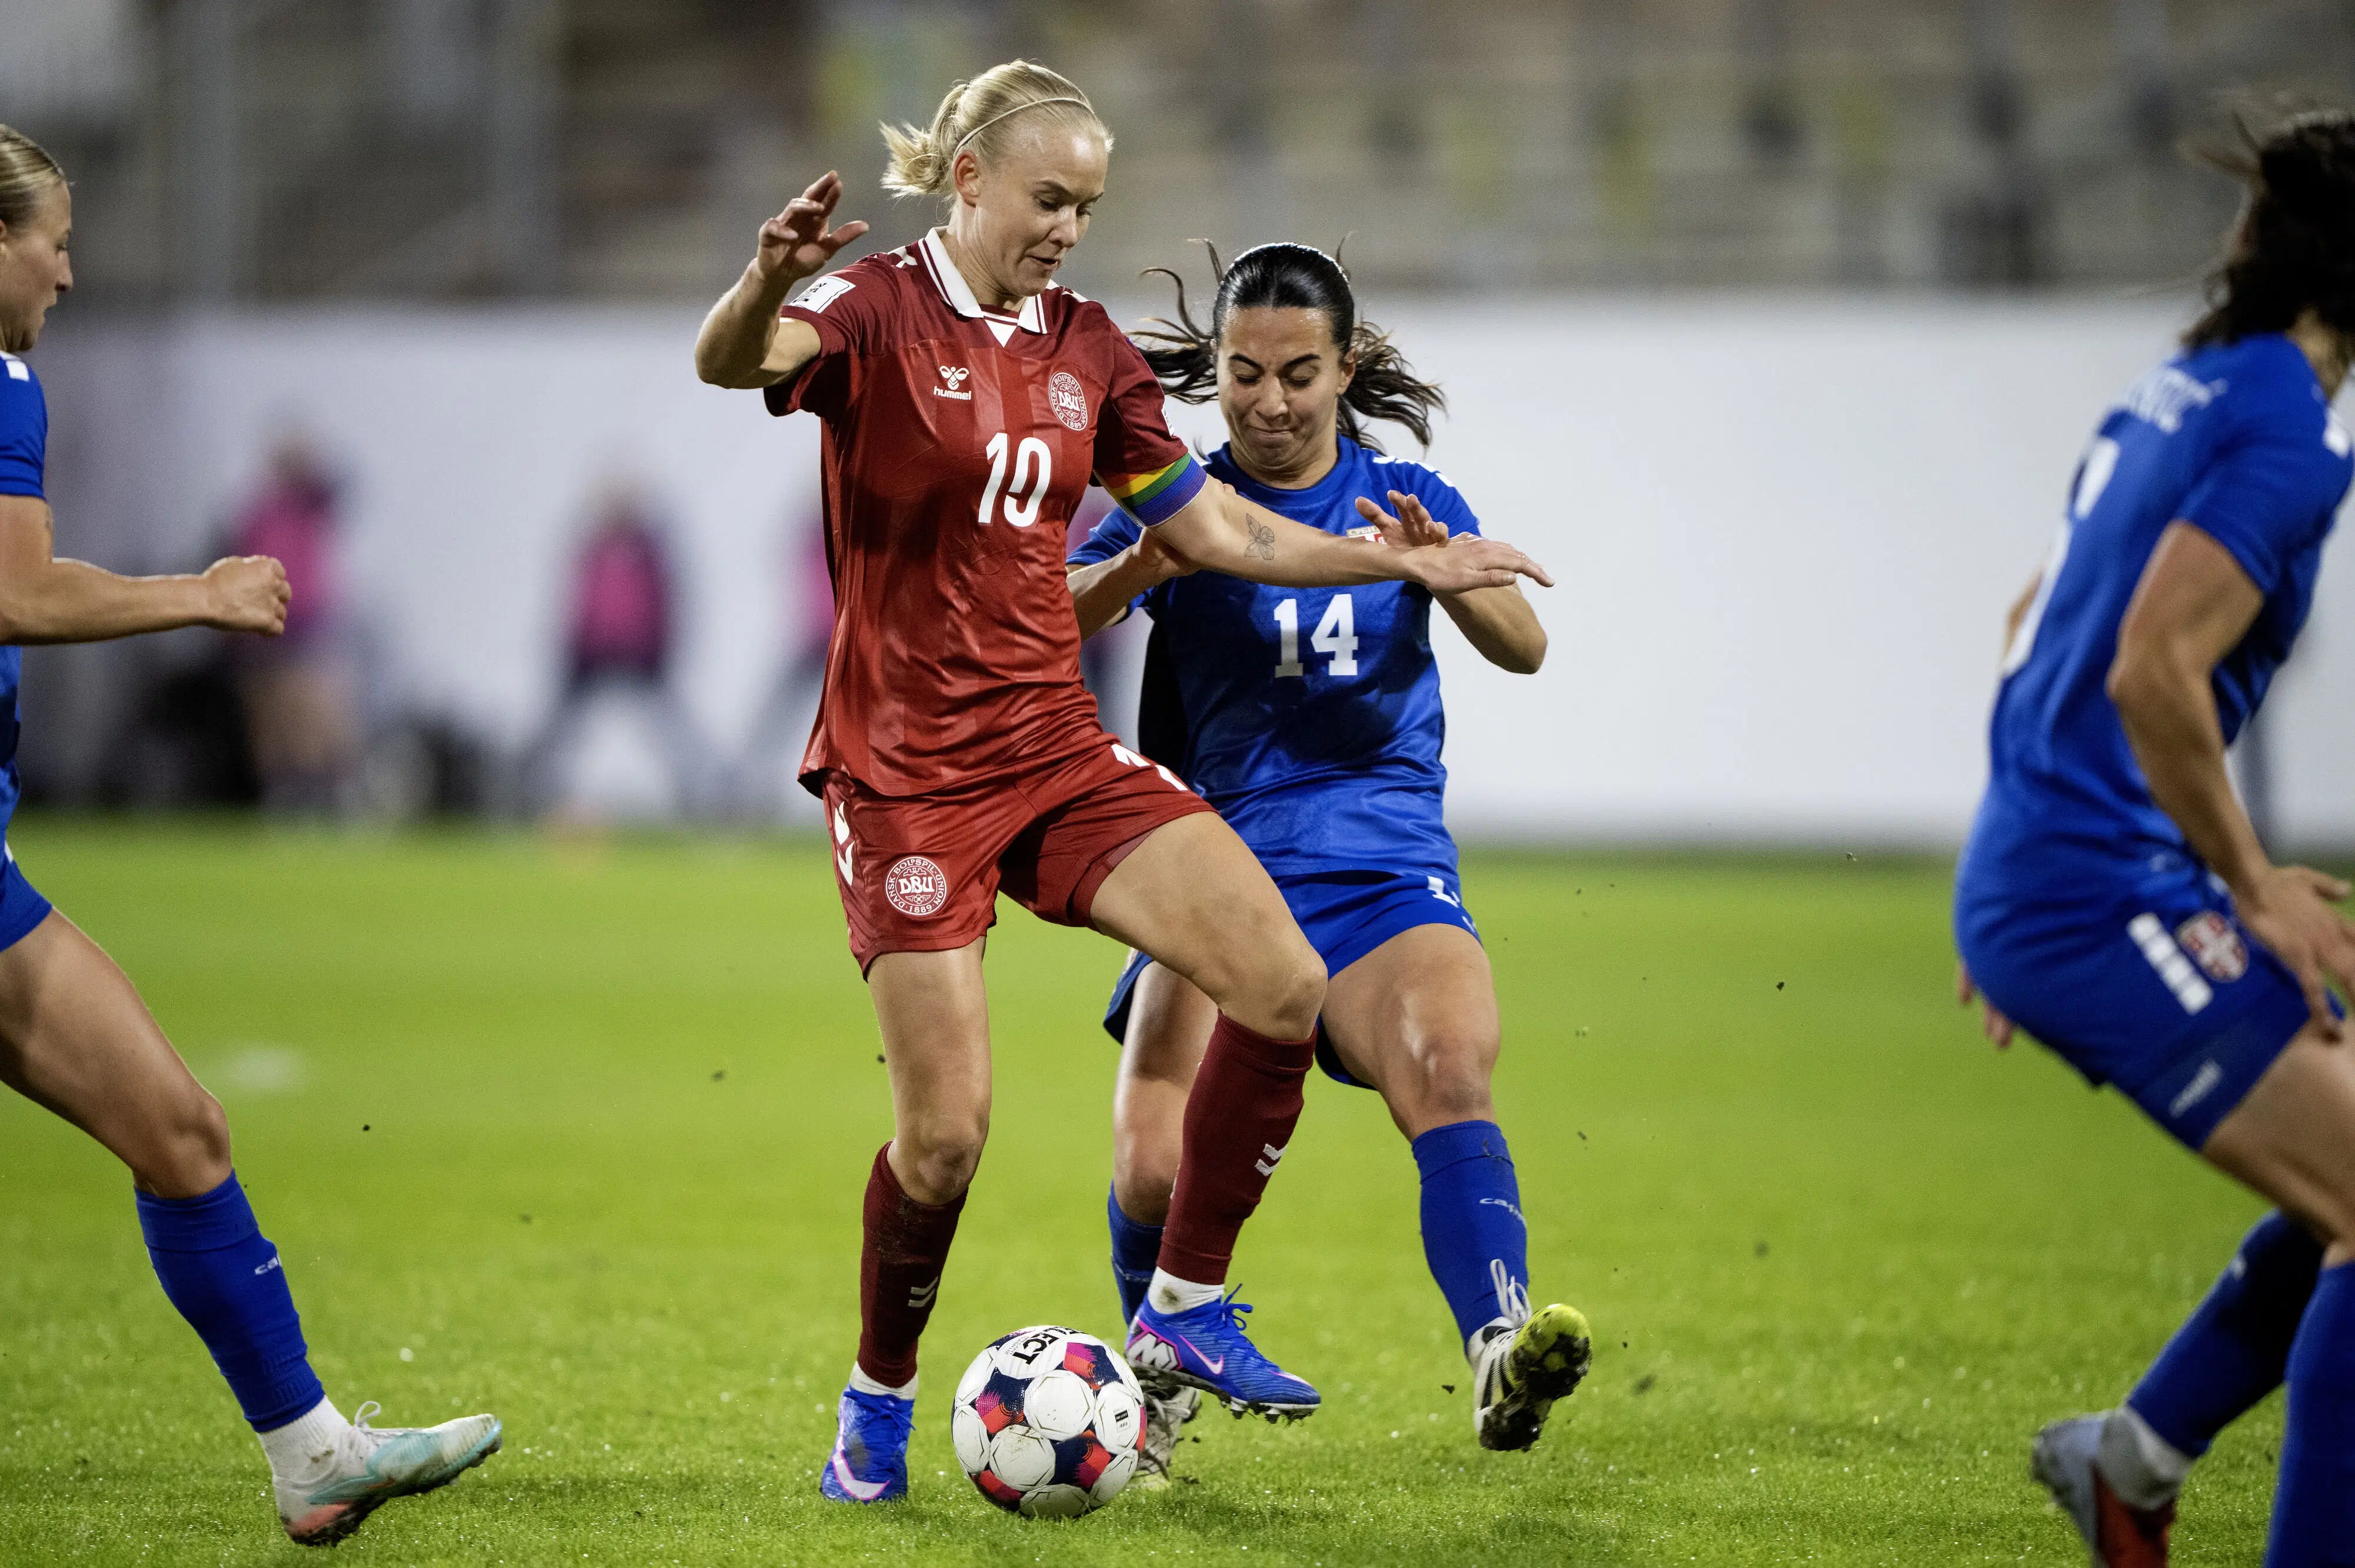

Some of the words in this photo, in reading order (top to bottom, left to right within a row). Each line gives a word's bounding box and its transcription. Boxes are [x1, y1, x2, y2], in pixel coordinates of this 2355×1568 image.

[933, 386, 971, 400] hummel
[1057, 391, 1081, 411] DBU
[1066, 419, 1082, 428] 1889
[978, 432, 1052, 527] 10
[1273, 593, 1359, 679] 14
[888, 876, 905, 908] DANSK
[933, 874, 944, 905] UNION
[898, 876, 935, 894] DBU
[909, 904, 933, 913] 1889
